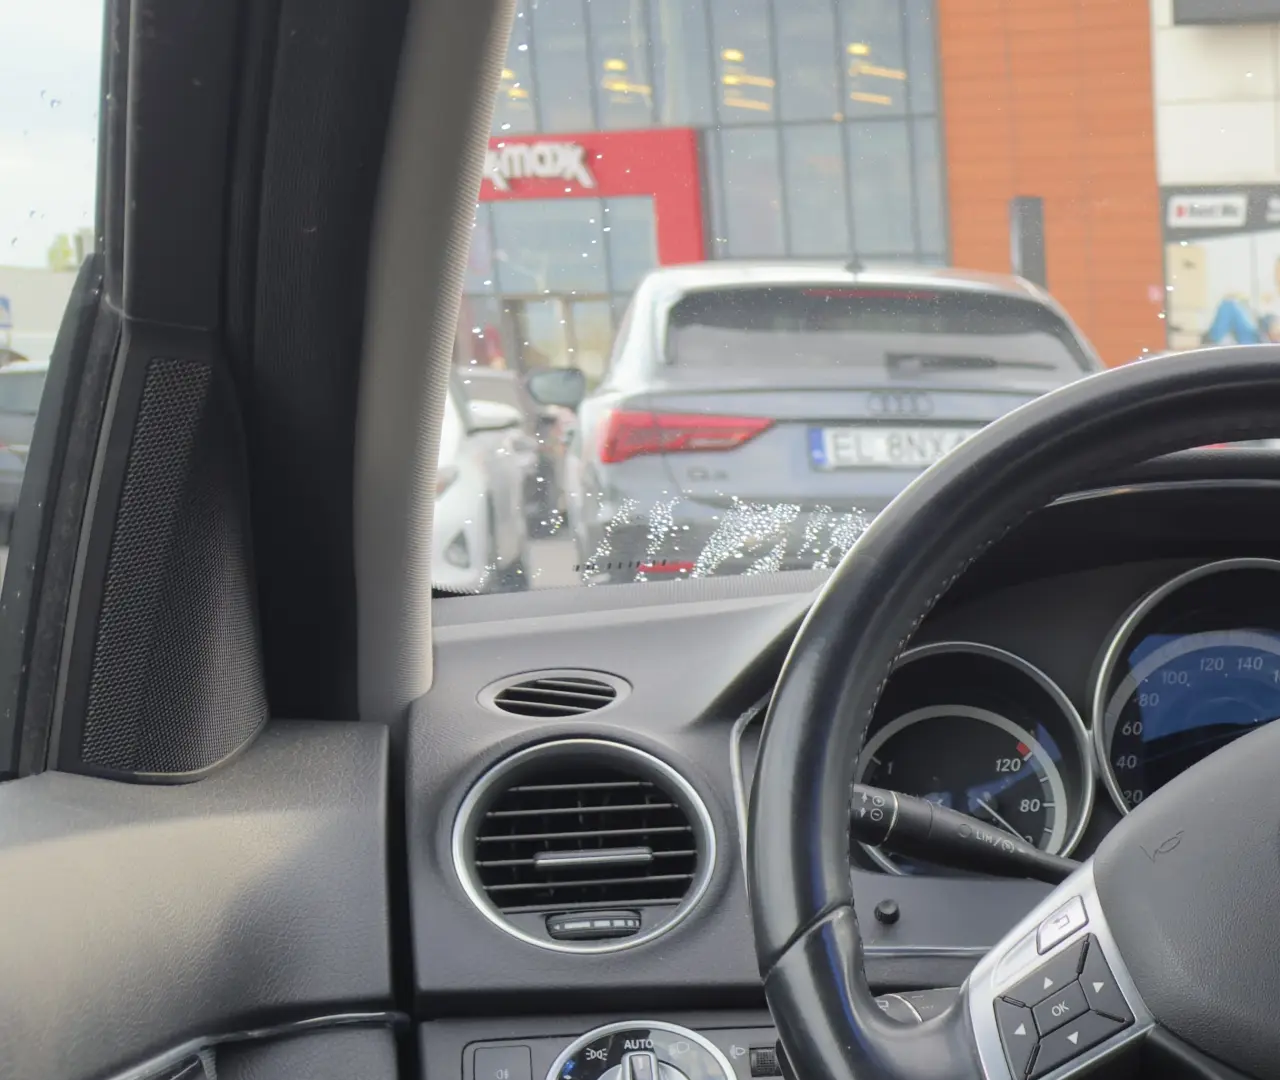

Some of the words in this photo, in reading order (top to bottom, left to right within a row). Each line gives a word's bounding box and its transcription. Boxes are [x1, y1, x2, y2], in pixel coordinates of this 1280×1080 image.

[833, 432, 874, 463] EL
[1200, 657, 1224, 671] 120
[1237, 657, 1263, 671] 140
[1162, 671, 1188, 685] 100
[1139, 693, 1159, 707] 80
[1121, 722, 1143, 736] 60
[996, 758, 1021, 772] 120
[1116, 755, 1137, 769] 40
[1020, 799, 1041, 813] 80
[1051, 1001, 1069, 1017] OK
[623, 1039, 654, 1050] AUTO
